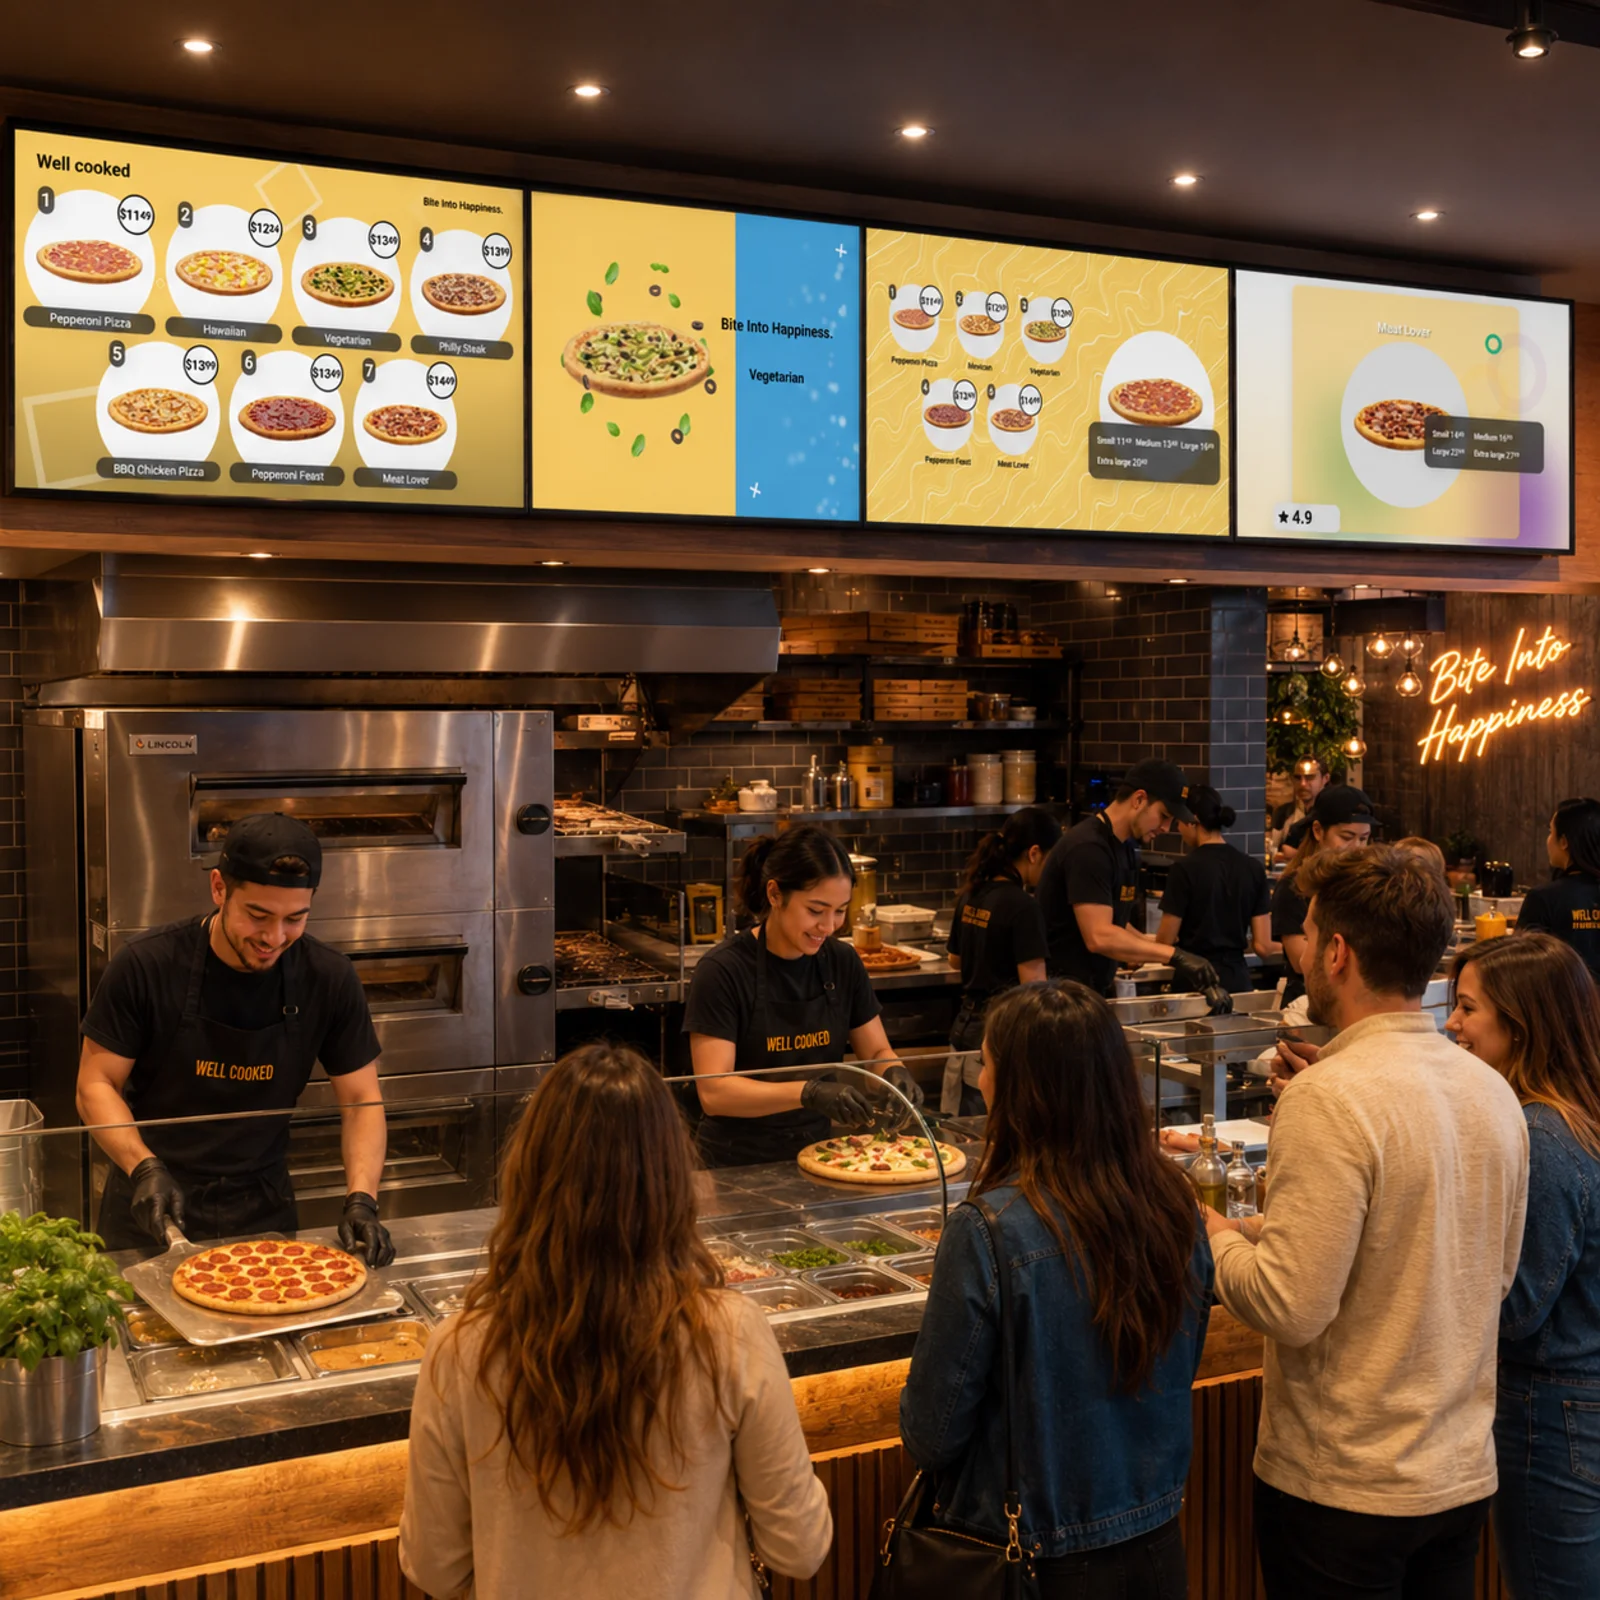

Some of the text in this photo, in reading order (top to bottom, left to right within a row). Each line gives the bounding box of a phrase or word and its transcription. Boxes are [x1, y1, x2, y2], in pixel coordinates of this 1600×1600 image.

[37, 153, 130, 178] Well cooked
[41, 193, 49, 207] 1
[423, 197, 504, 214] Bite Into Happiness.
[181, 208, 191, 222] 2
[305, 221, 314, 235] 3
[423, 233, 431, 245] 4
[50, 313, 132, 329] Pepperoni Pizza
[203, 325, 247, 337] Hawaiian
[722, 318, 833, 339] Bite Into Happiness.
[1378, 321, 1431, 339] Meat Lover
[325, 334, 372, 347] Vegetarian
[113, 347, 122, 361] 5
[439, 342, 487, 355] Philly Steak
[245, 356, 254, 370] 6
[365, 364, 374, 377] 7
[749, 369, 805, 385] Vegetarian
[114, 464, 205, 477] BBQ Chicken Pizza
[252, 469, 325, 482] Pepperoni Feast
[383, 474, 430, 485] Meat Lover
[1292, 510, 1313, 525] 4.9
[1430, 626, 1572, 705] Bite Into
[1417, 688, 1592, 765] Happiness
[147, 741, 193, 749] LINCOLN
[767, 1030, 831, 1052] WELL COOKED
[196, 1060, 274, 1081] WELL COOKED
